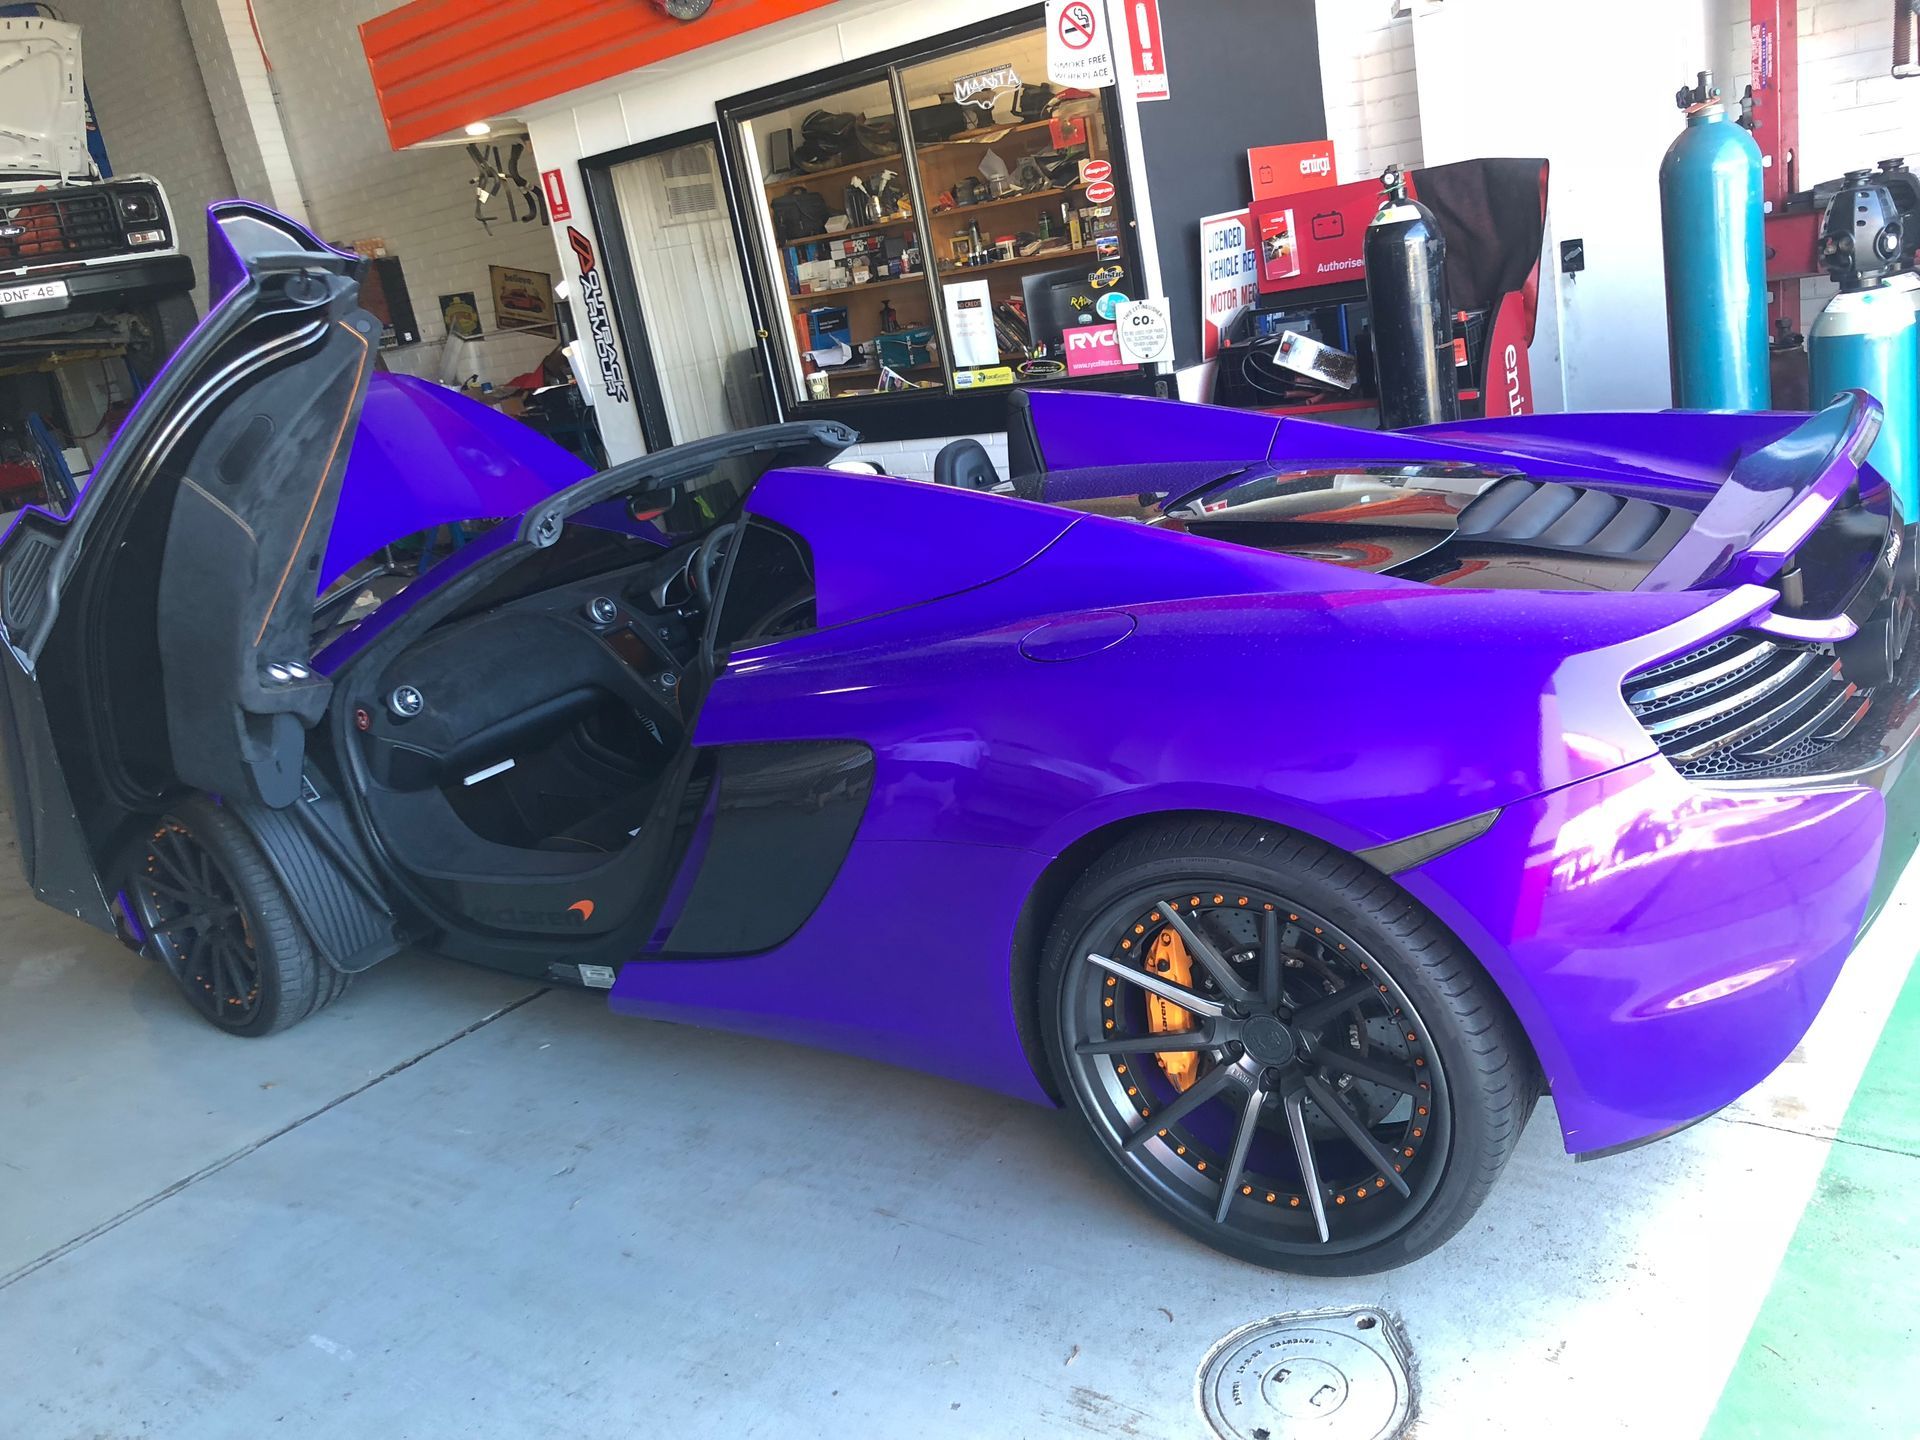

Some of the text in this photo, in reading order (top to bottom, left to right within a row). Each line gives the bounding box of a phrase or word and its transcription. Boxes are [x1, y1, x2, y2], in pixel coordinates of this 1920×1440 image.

[1088, 54, 1107, 65] FREE
[1300, 152, 1331, 177] enirgi
[1208, 226, 1242, 253] LICENCED
[1209, 250, 1257, 281] VEHICLE REP
[1211, 282, 1257, 315] MOTOR MEC
[579, 274, 618, 398] ARMOUR
[587, 269, 629, 404] OUTBACK
[1072, 360, 1121, 370] www.rycofilters.co
